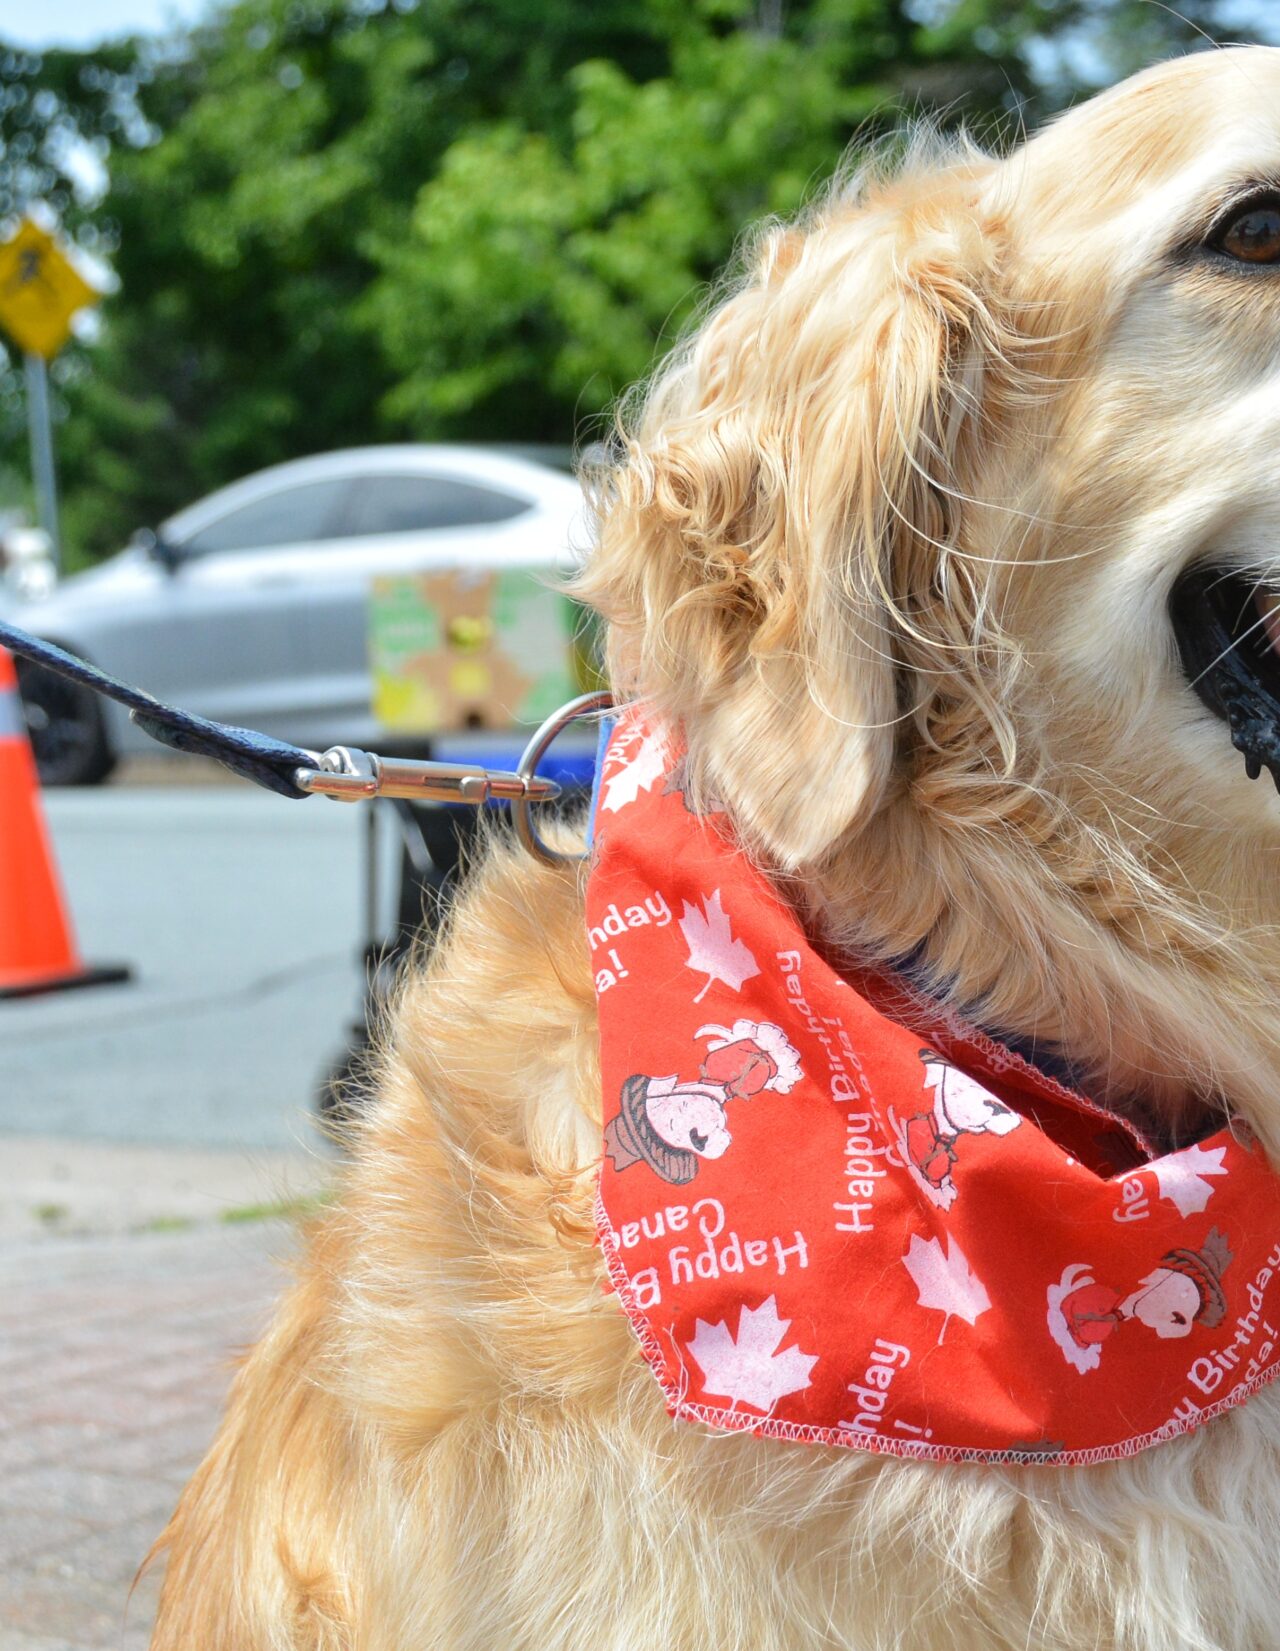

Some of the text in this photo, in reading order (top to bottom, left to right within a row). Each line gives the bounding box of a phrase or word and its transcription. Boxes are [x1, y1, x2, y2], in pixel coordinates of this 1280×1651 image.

[776, 950, 886, 1233] Happy Birthday
[1112, 1178, 1150, 1223] ay
[668, 1231, 809, 1285] Happy
[838, 1338, 911, 1436] hday
